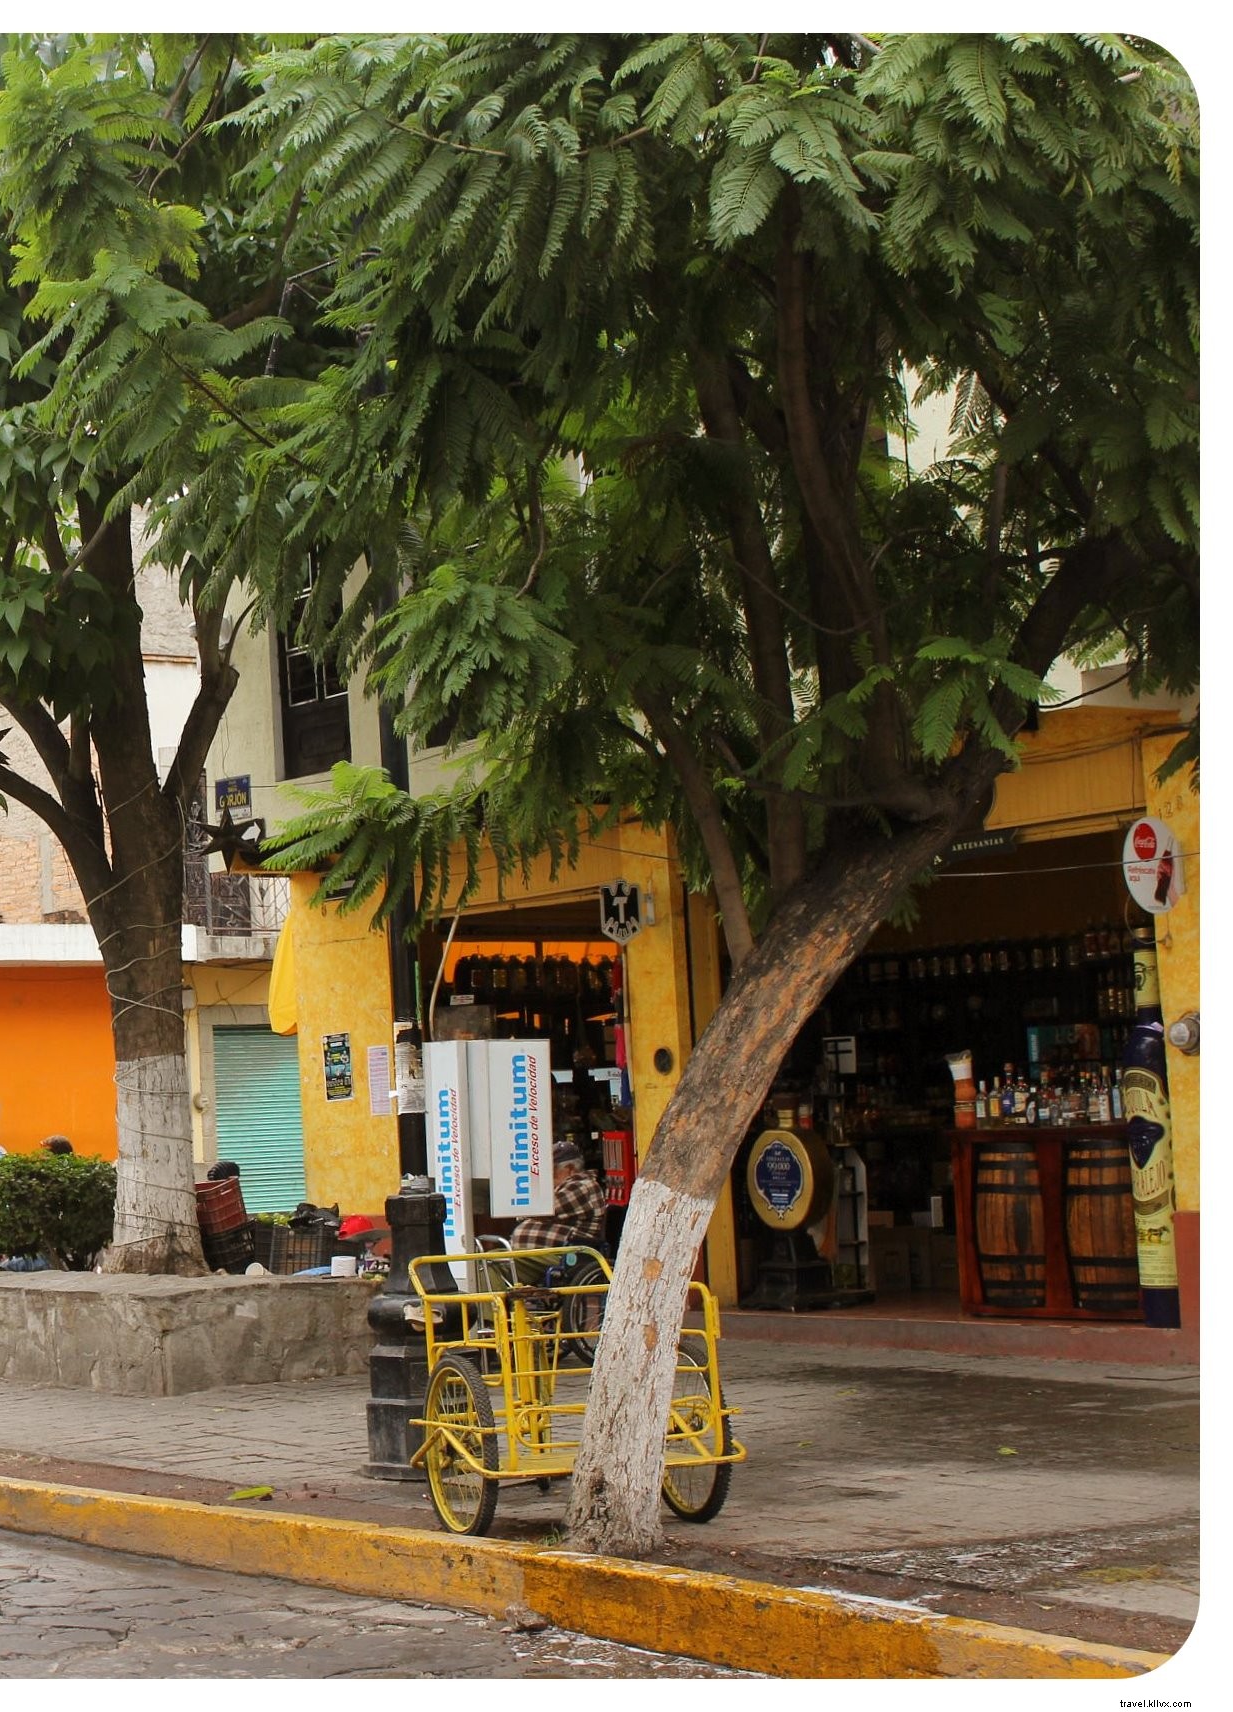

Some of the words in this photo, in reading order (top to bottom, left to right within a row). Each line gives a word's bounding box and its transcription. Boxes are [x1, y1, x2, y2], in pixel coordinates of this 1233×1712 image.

[527, 1055, 538, 1113] Velocidad
[449, 1088, 459, 1145] Velocidad
[509, 1054, 530, 1206] infinitum
[529, 1115, 539, 1131] de
[451, 1147, 460, 1162] de
[530, 1132, 540, 1176] Exceso
[453, 1165, 462, 1207] Exceso
